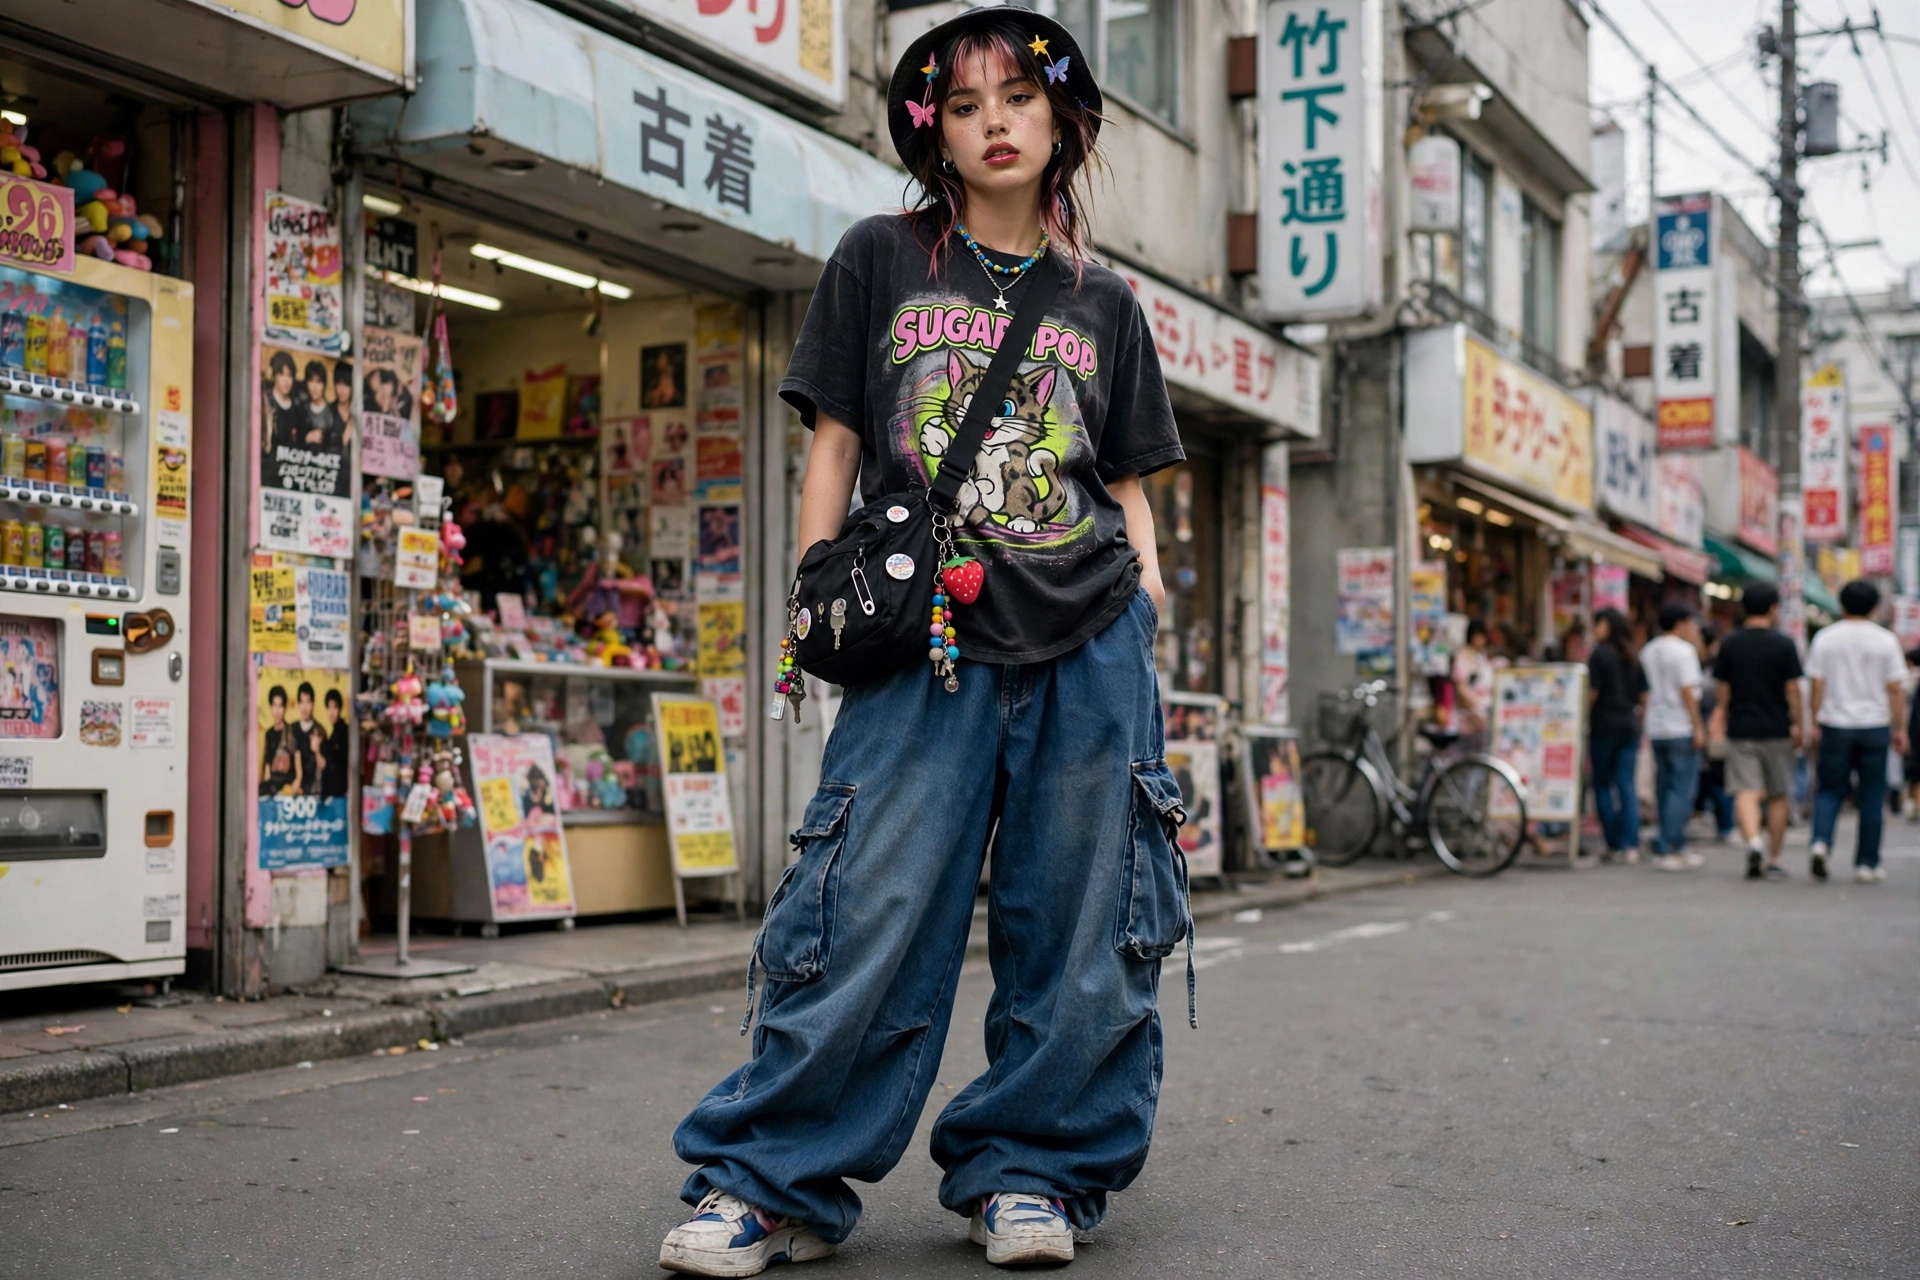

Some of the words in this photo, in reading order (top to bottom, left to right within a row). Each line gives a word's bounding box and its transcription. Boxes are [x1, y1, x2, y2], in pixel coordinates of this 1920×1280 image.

[633, 86, 755, 215] 古着
[1278, 8, 1347, 297] 竹下通り
[1031, 322, 1098, 381] POP
[1664, 286, 1706, 384] 古着
